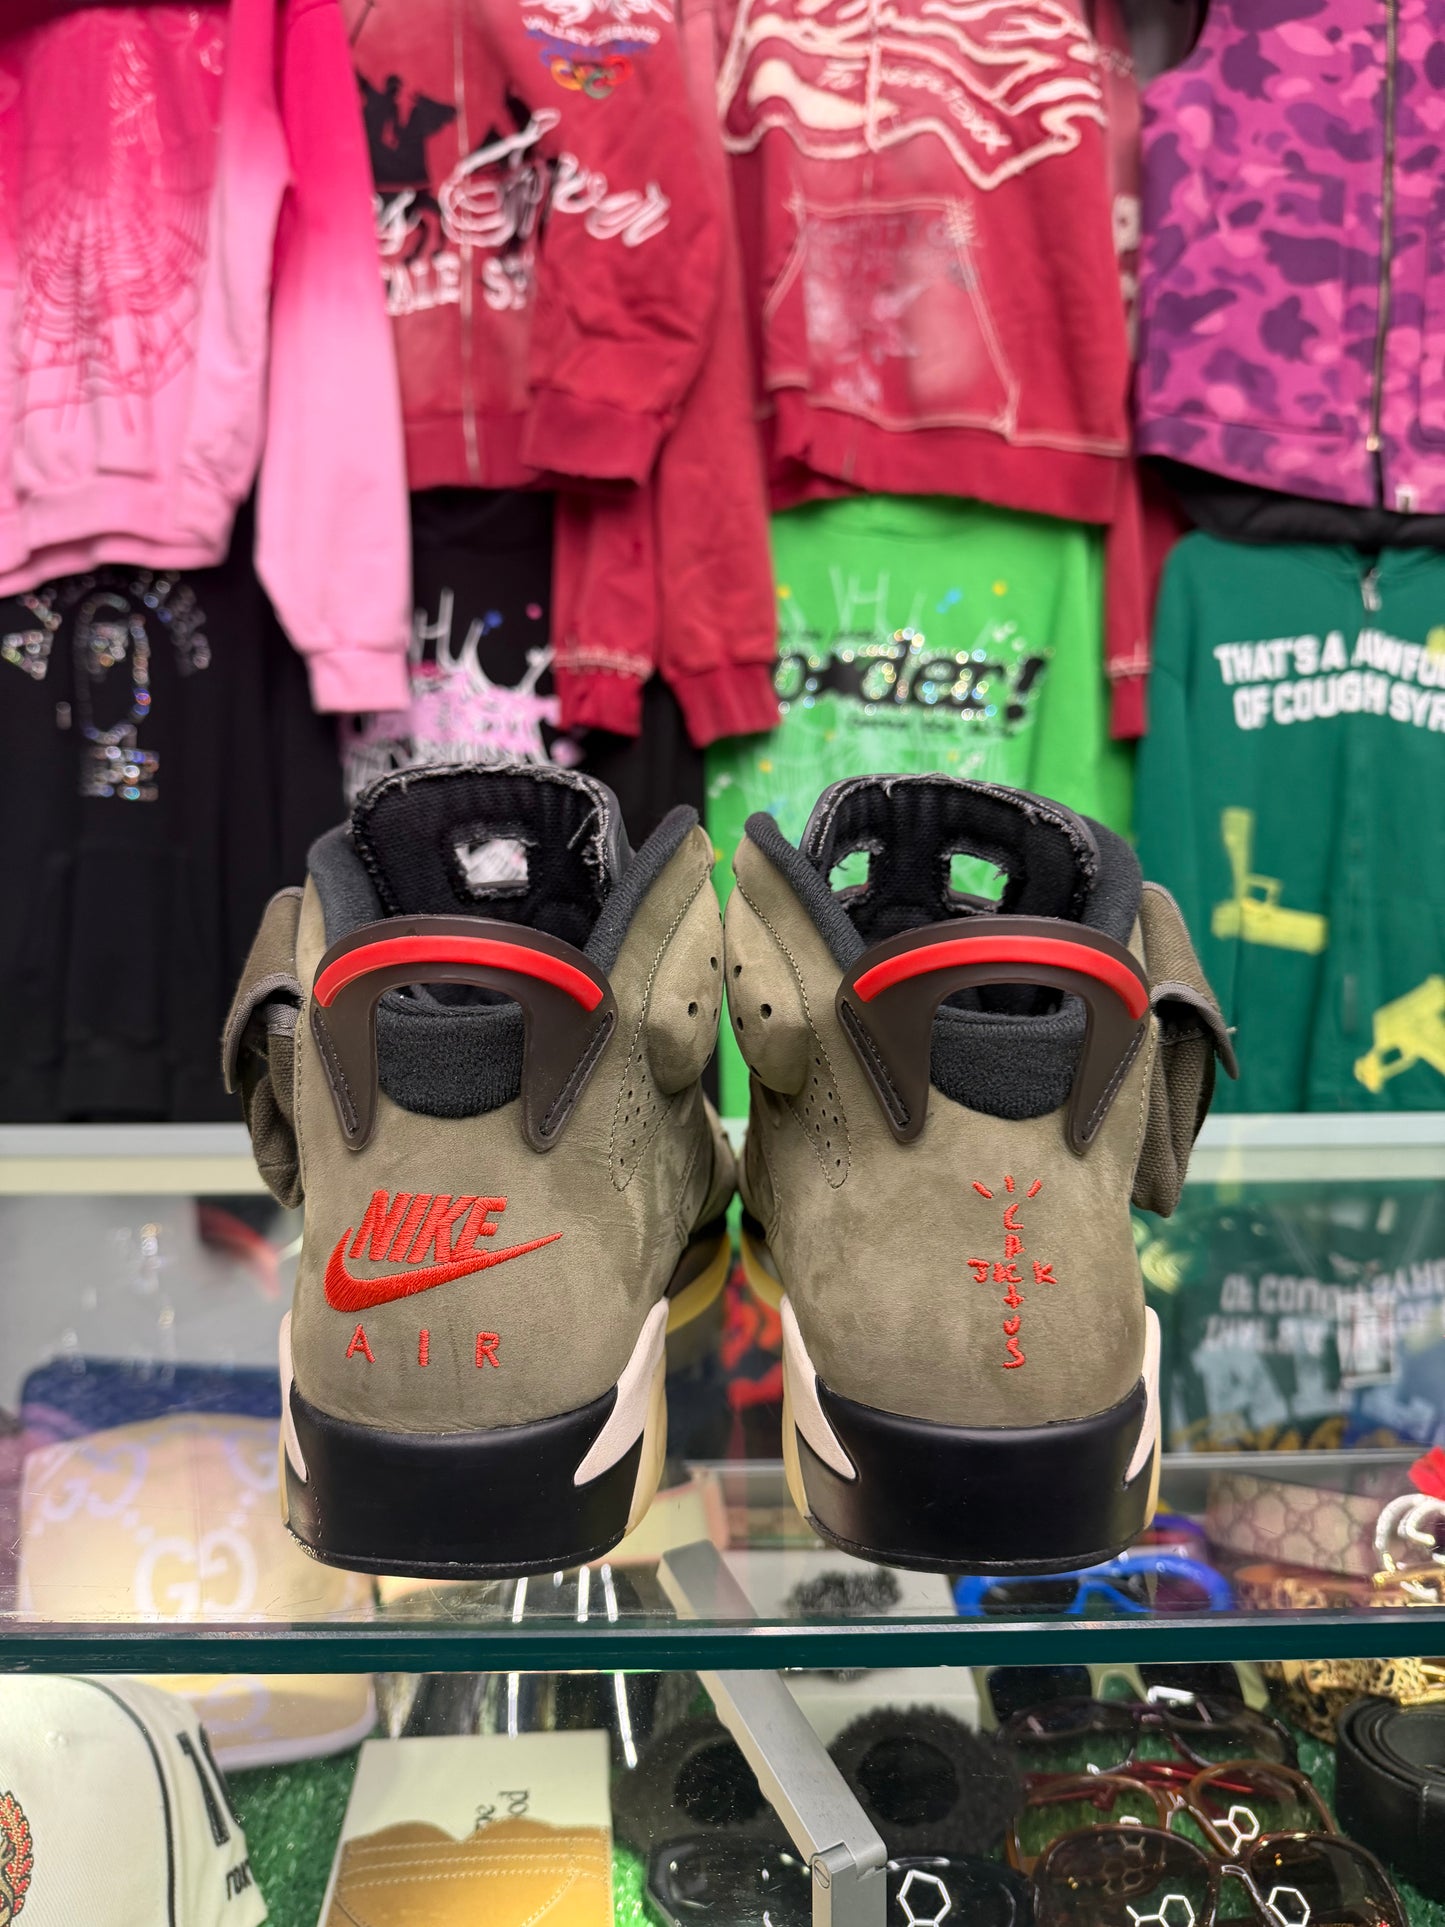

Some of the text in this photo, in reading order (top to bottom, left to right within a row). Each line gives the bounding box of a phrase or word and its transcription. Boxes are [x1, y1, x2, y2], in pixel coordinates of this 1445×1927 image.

[1213, 634, 1320, 686] THAT'S
[1319, 630, 1348, 671] A
[1232, 684, 1271, 731] OF
[1273, 669, 1390, 725] COUGH
[348, 1188, 508, 1264] NIKE
[345, 1323, 501, 1369] AIR
